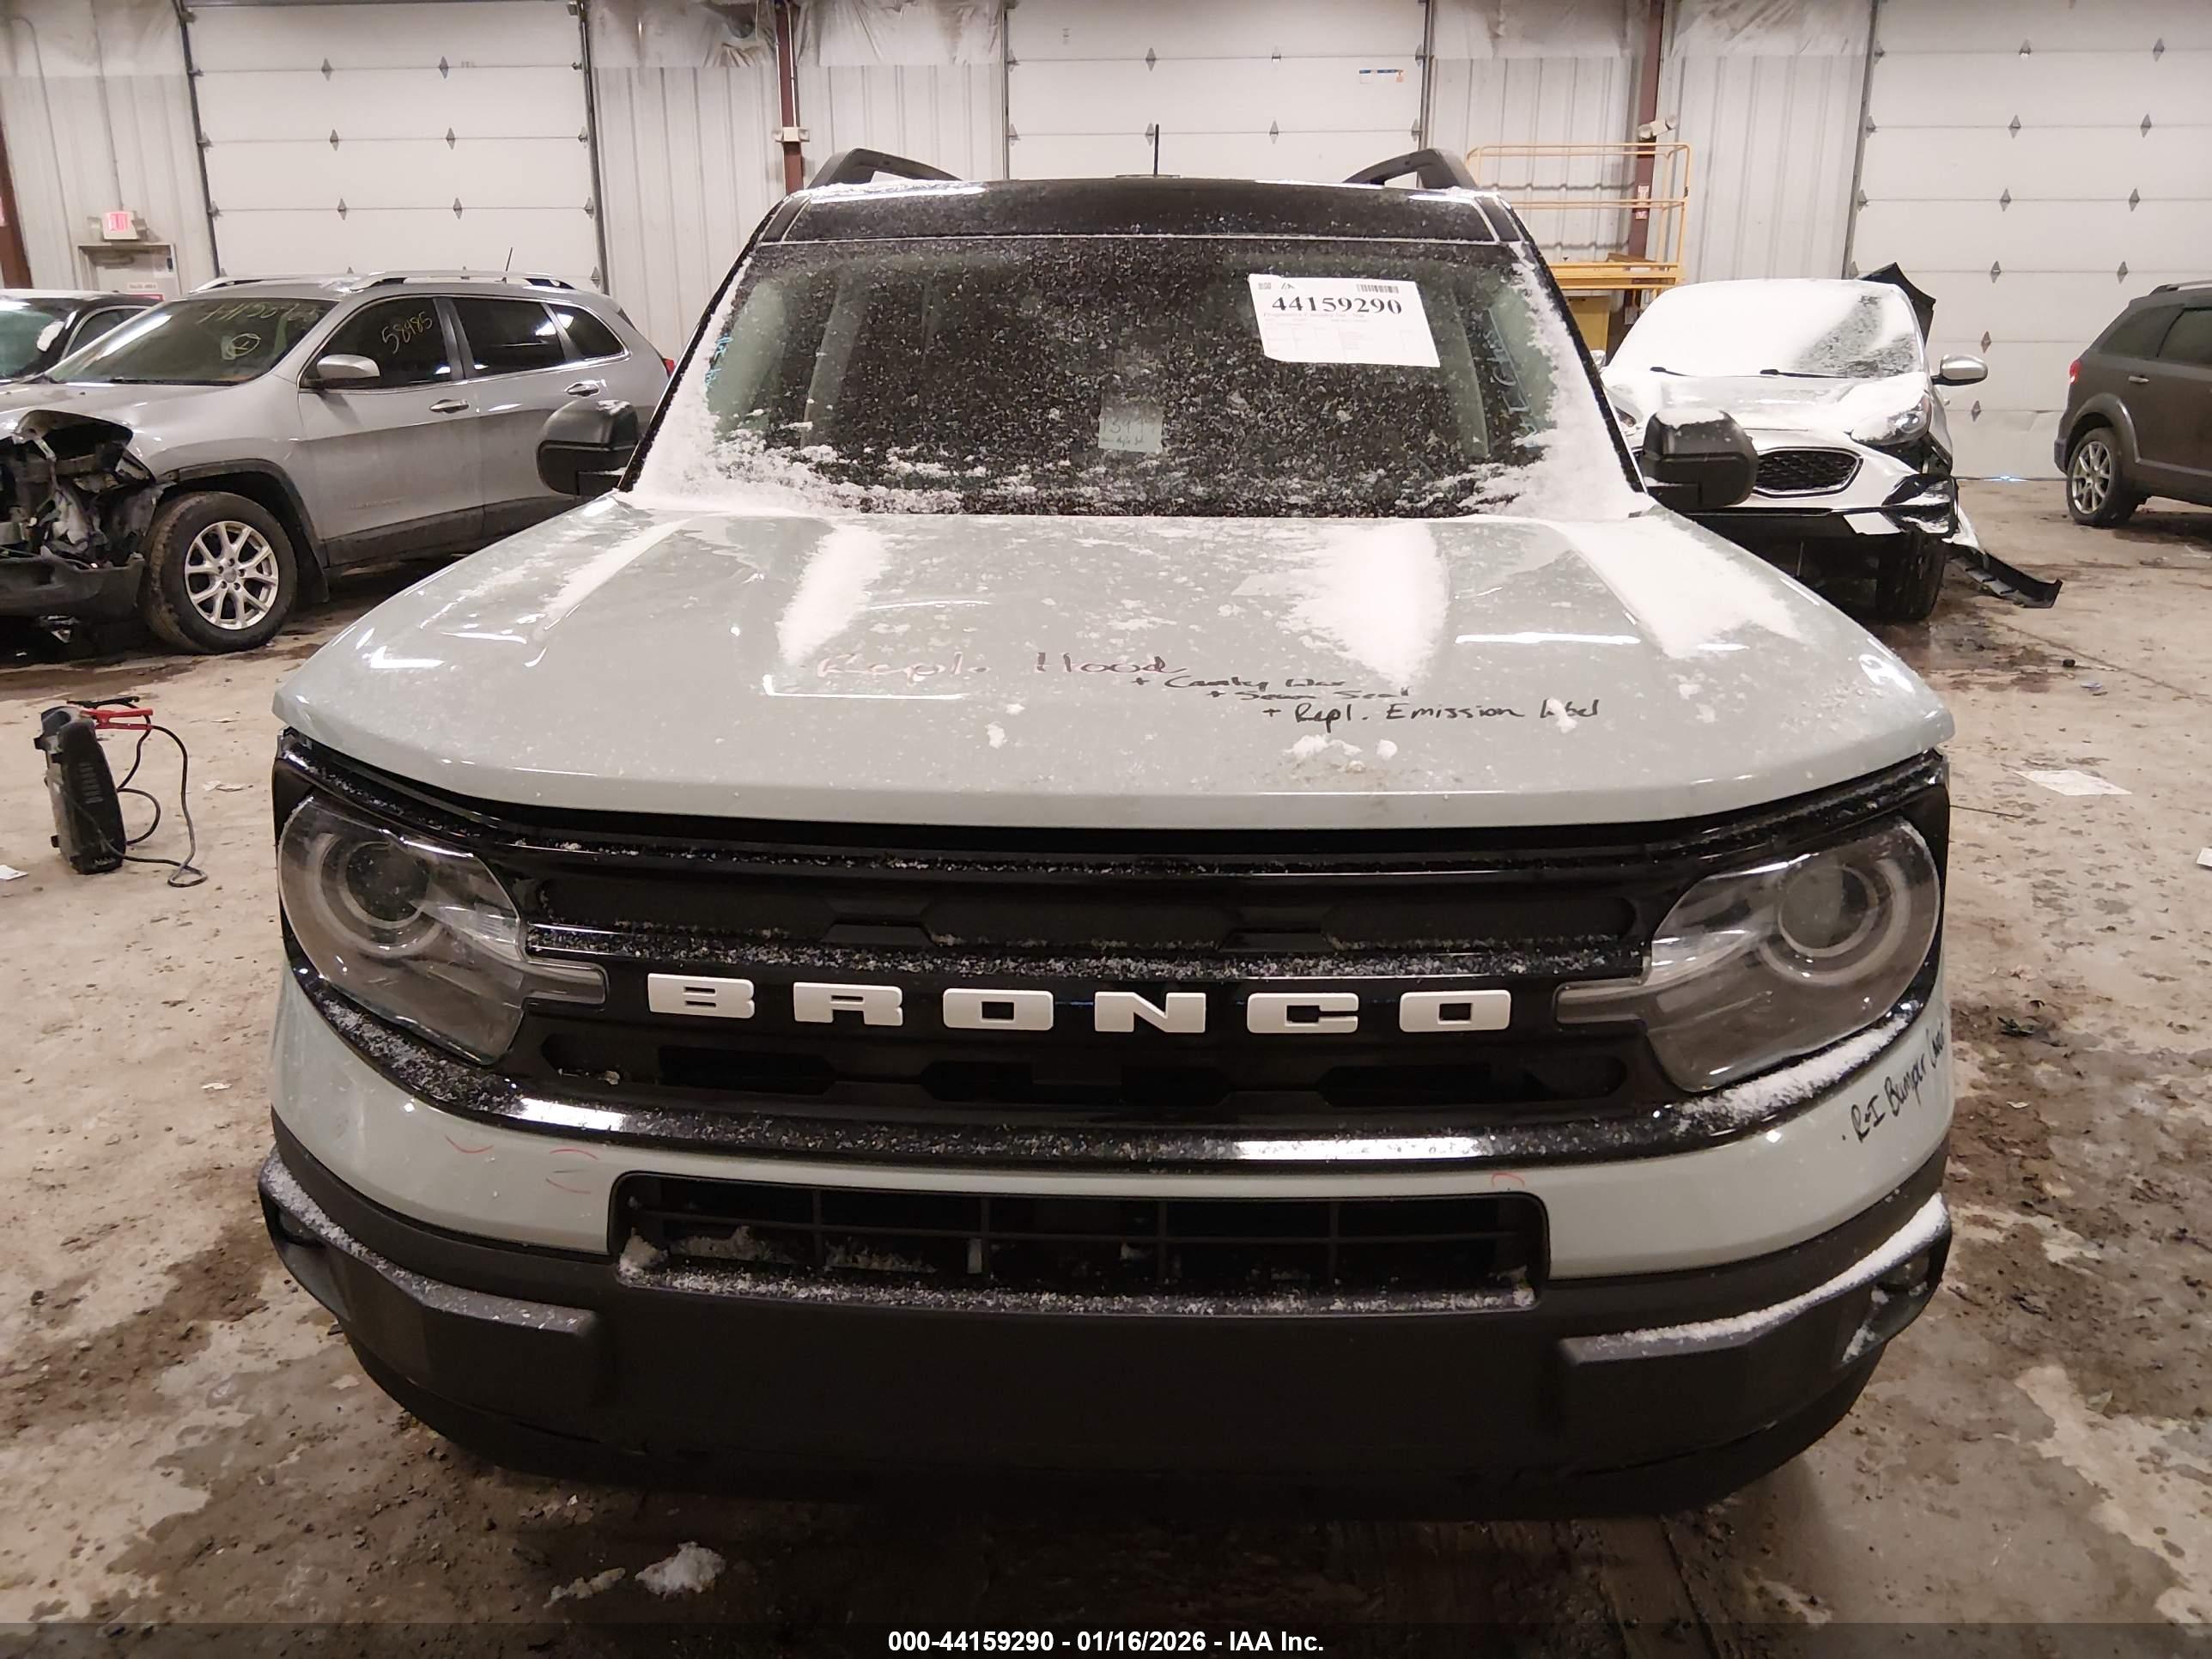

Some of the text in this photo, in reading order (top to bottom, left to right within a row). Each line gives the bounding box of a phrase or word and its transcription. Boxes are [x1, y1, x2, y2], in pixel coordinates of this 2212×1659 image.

[1272, 295, 1402, 315] 44159290
[1386, 702, 1526, 720] Emission
[647, 972, 1513, 1033] BRONCO
